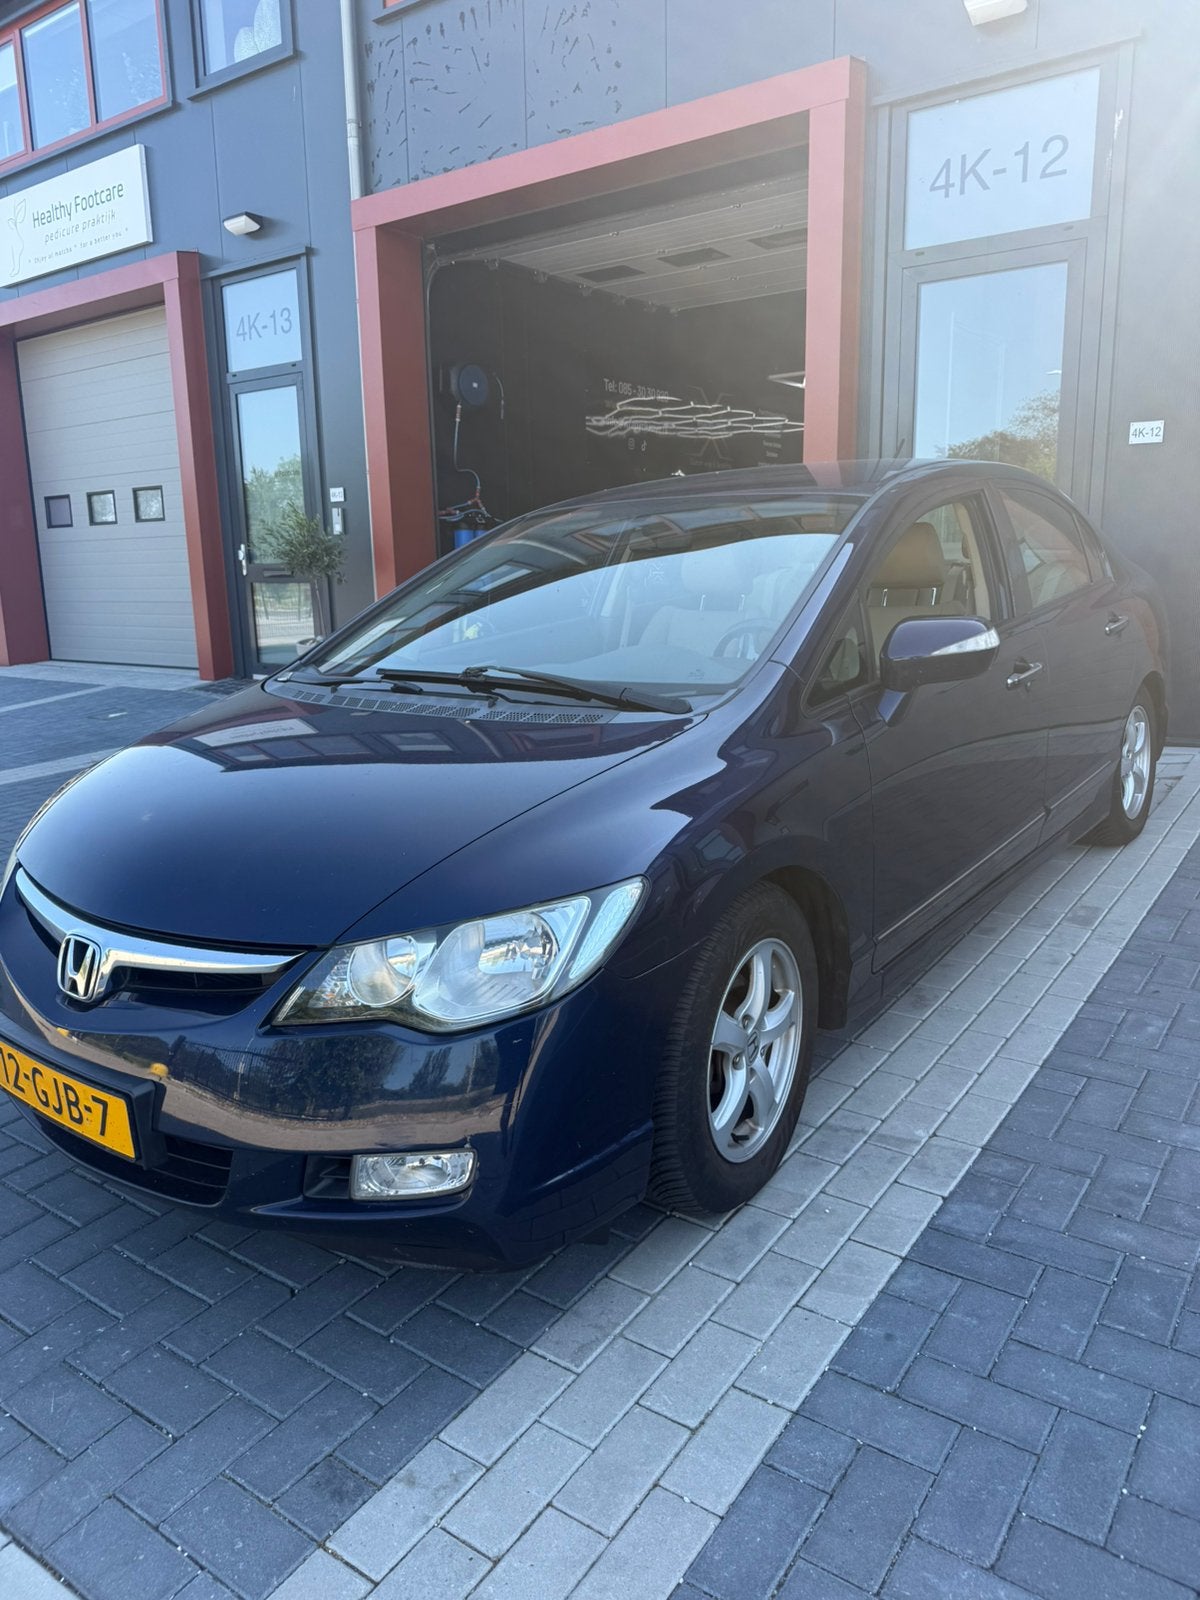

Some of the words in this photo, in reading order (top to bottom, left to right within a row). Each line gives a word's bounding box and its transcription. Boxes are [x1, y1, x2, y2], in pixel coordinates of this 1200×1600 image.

[929, 134, 1070, 198] 4K-12
[32, 200, 72, 229] Healthy
[74, 183, 124, 214] Footcare
[44, 223, 80, 245] pedicure
[82, 208, 116, 232] praktijk
[236, 307, 292, 342] 4K-13
[603, 378, 618, 393] Tel:
[618, 381, 632, 396] 085
[1131, 426, 1162, 438] 4K-12
[0, 1046, 109, 1137] 12-GJB-7
